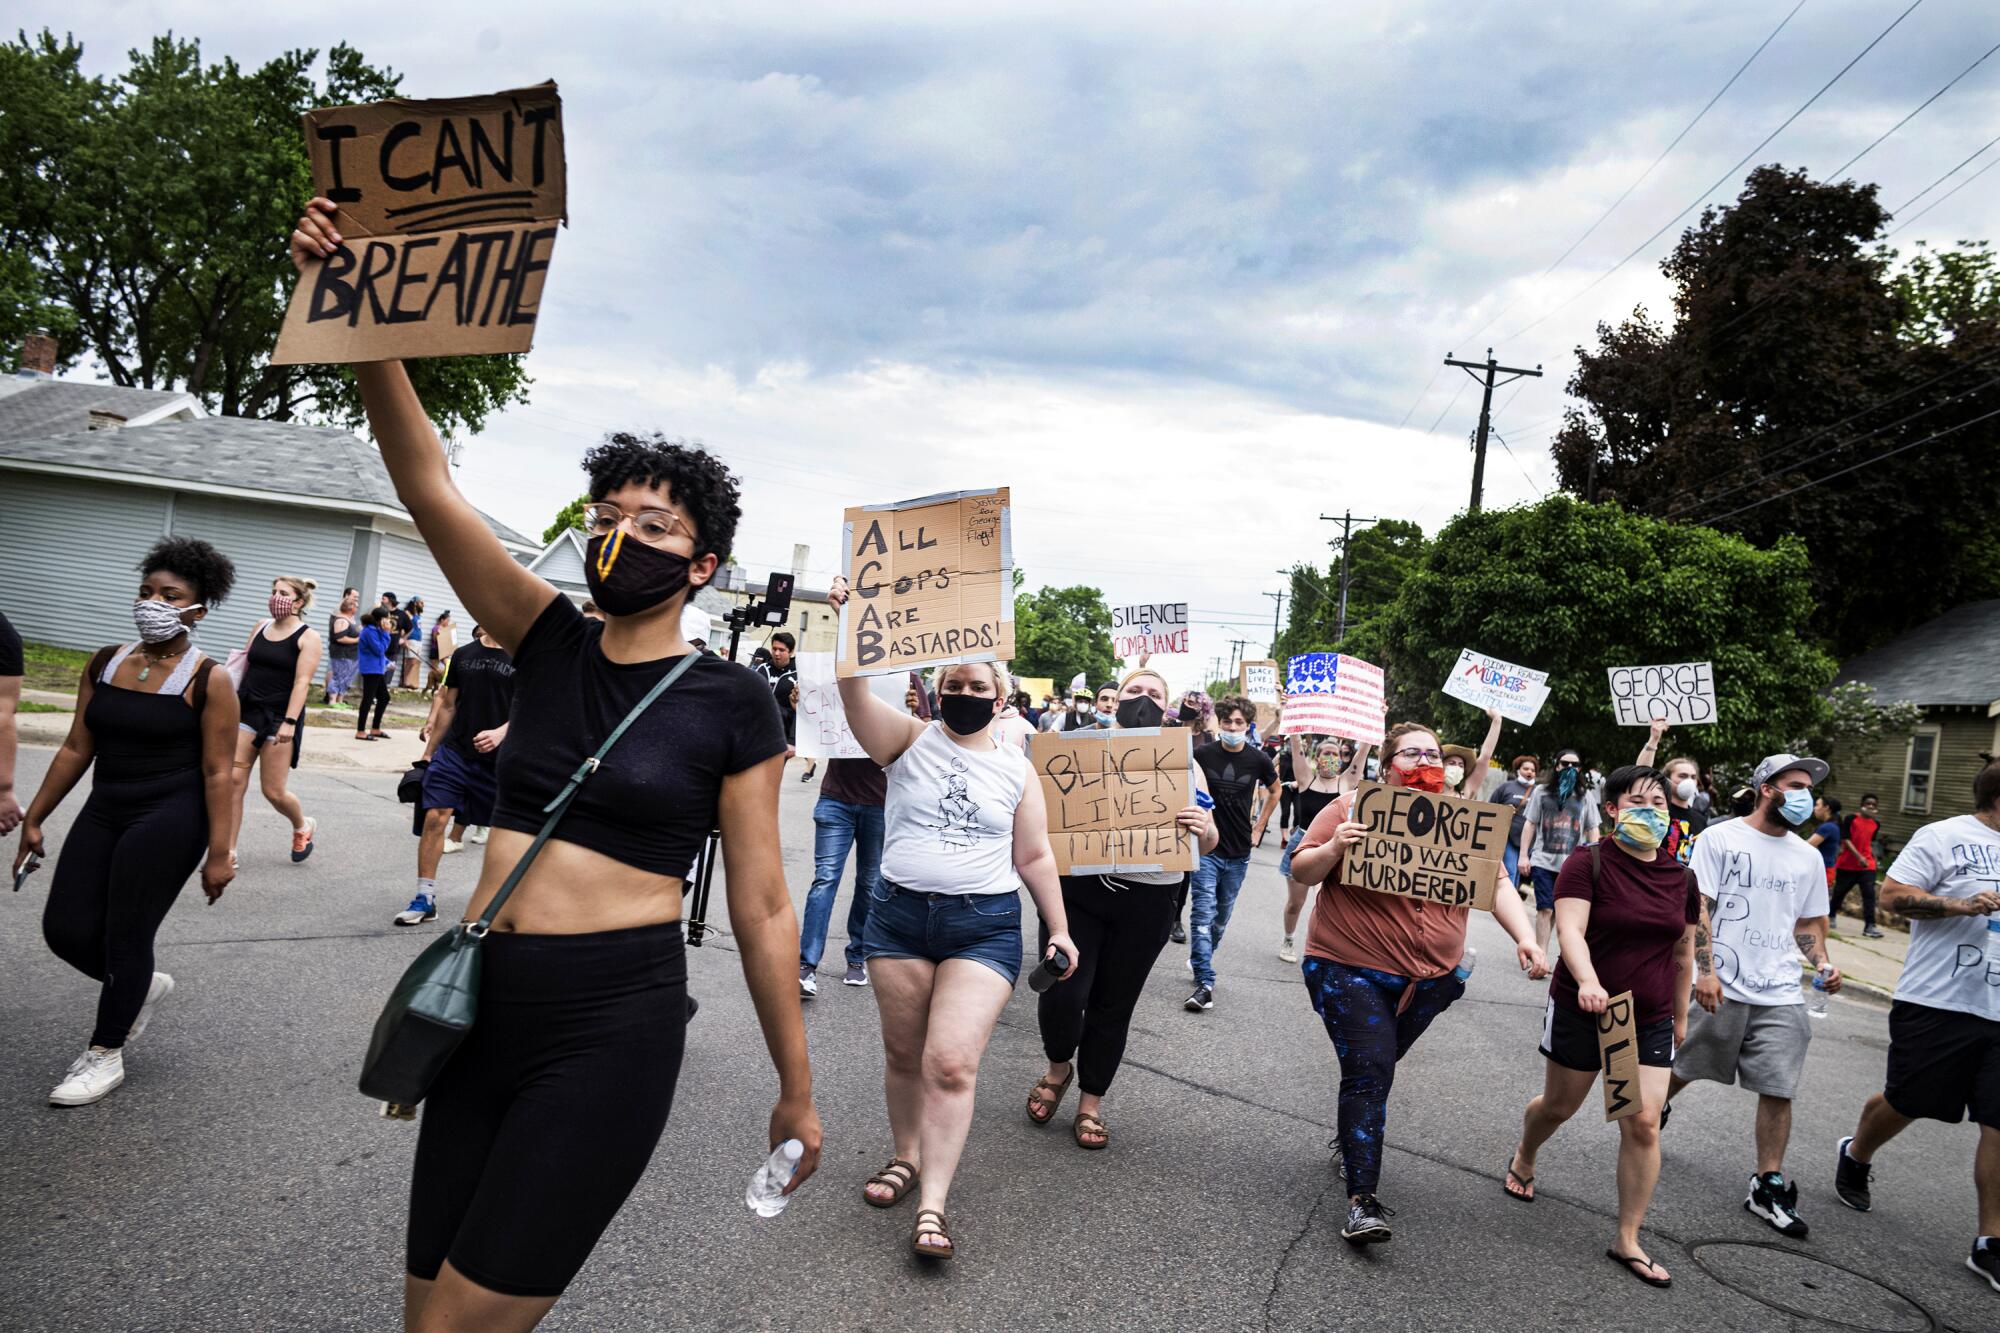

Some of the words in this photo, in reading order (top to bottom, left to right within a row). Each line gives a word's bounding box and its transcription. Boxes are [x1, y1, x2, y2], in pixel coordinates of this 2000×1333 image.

[317, 125, 363, 203] I
[379, 96, 557, 194] CAN'T
[307, 228, 556, 328] BREATHE
[856, 519, 938, 557] ALL
[967, 528, 994, 547] Floyd
[857, 603, 920, 631] ARE
[1113, 603, 1187, 628] SILENCE
[1141, 624, 1152, 635] IS
[856, 620, 1001, 667] BASTARDS!
[1113, 629, 1189, 660] COMPLIANCE
[1462, 650, 1475, 661] I
[1288, 654, 1337, 679] FUCK
[1465, 664, 1528, 692] MURDERS
[1612, 664, 1711, 697] GEORGE
[1618, 695, 1711, 723] FLOYD
[1045, 748, 1177, 796] BLACK
[1061, 789, 1168, 829] LIVES
[1357, 787, 1497, 851] GEORGE
[1069, 817, 1191, 863] MATTER
[1351, 837, 1413, 866] FLOYD
[1419, 846, 1469, 873] WAS
[1348, 860, 1477, 907] MURDERED!
[1599, 999, 1633, 1115] BLM
